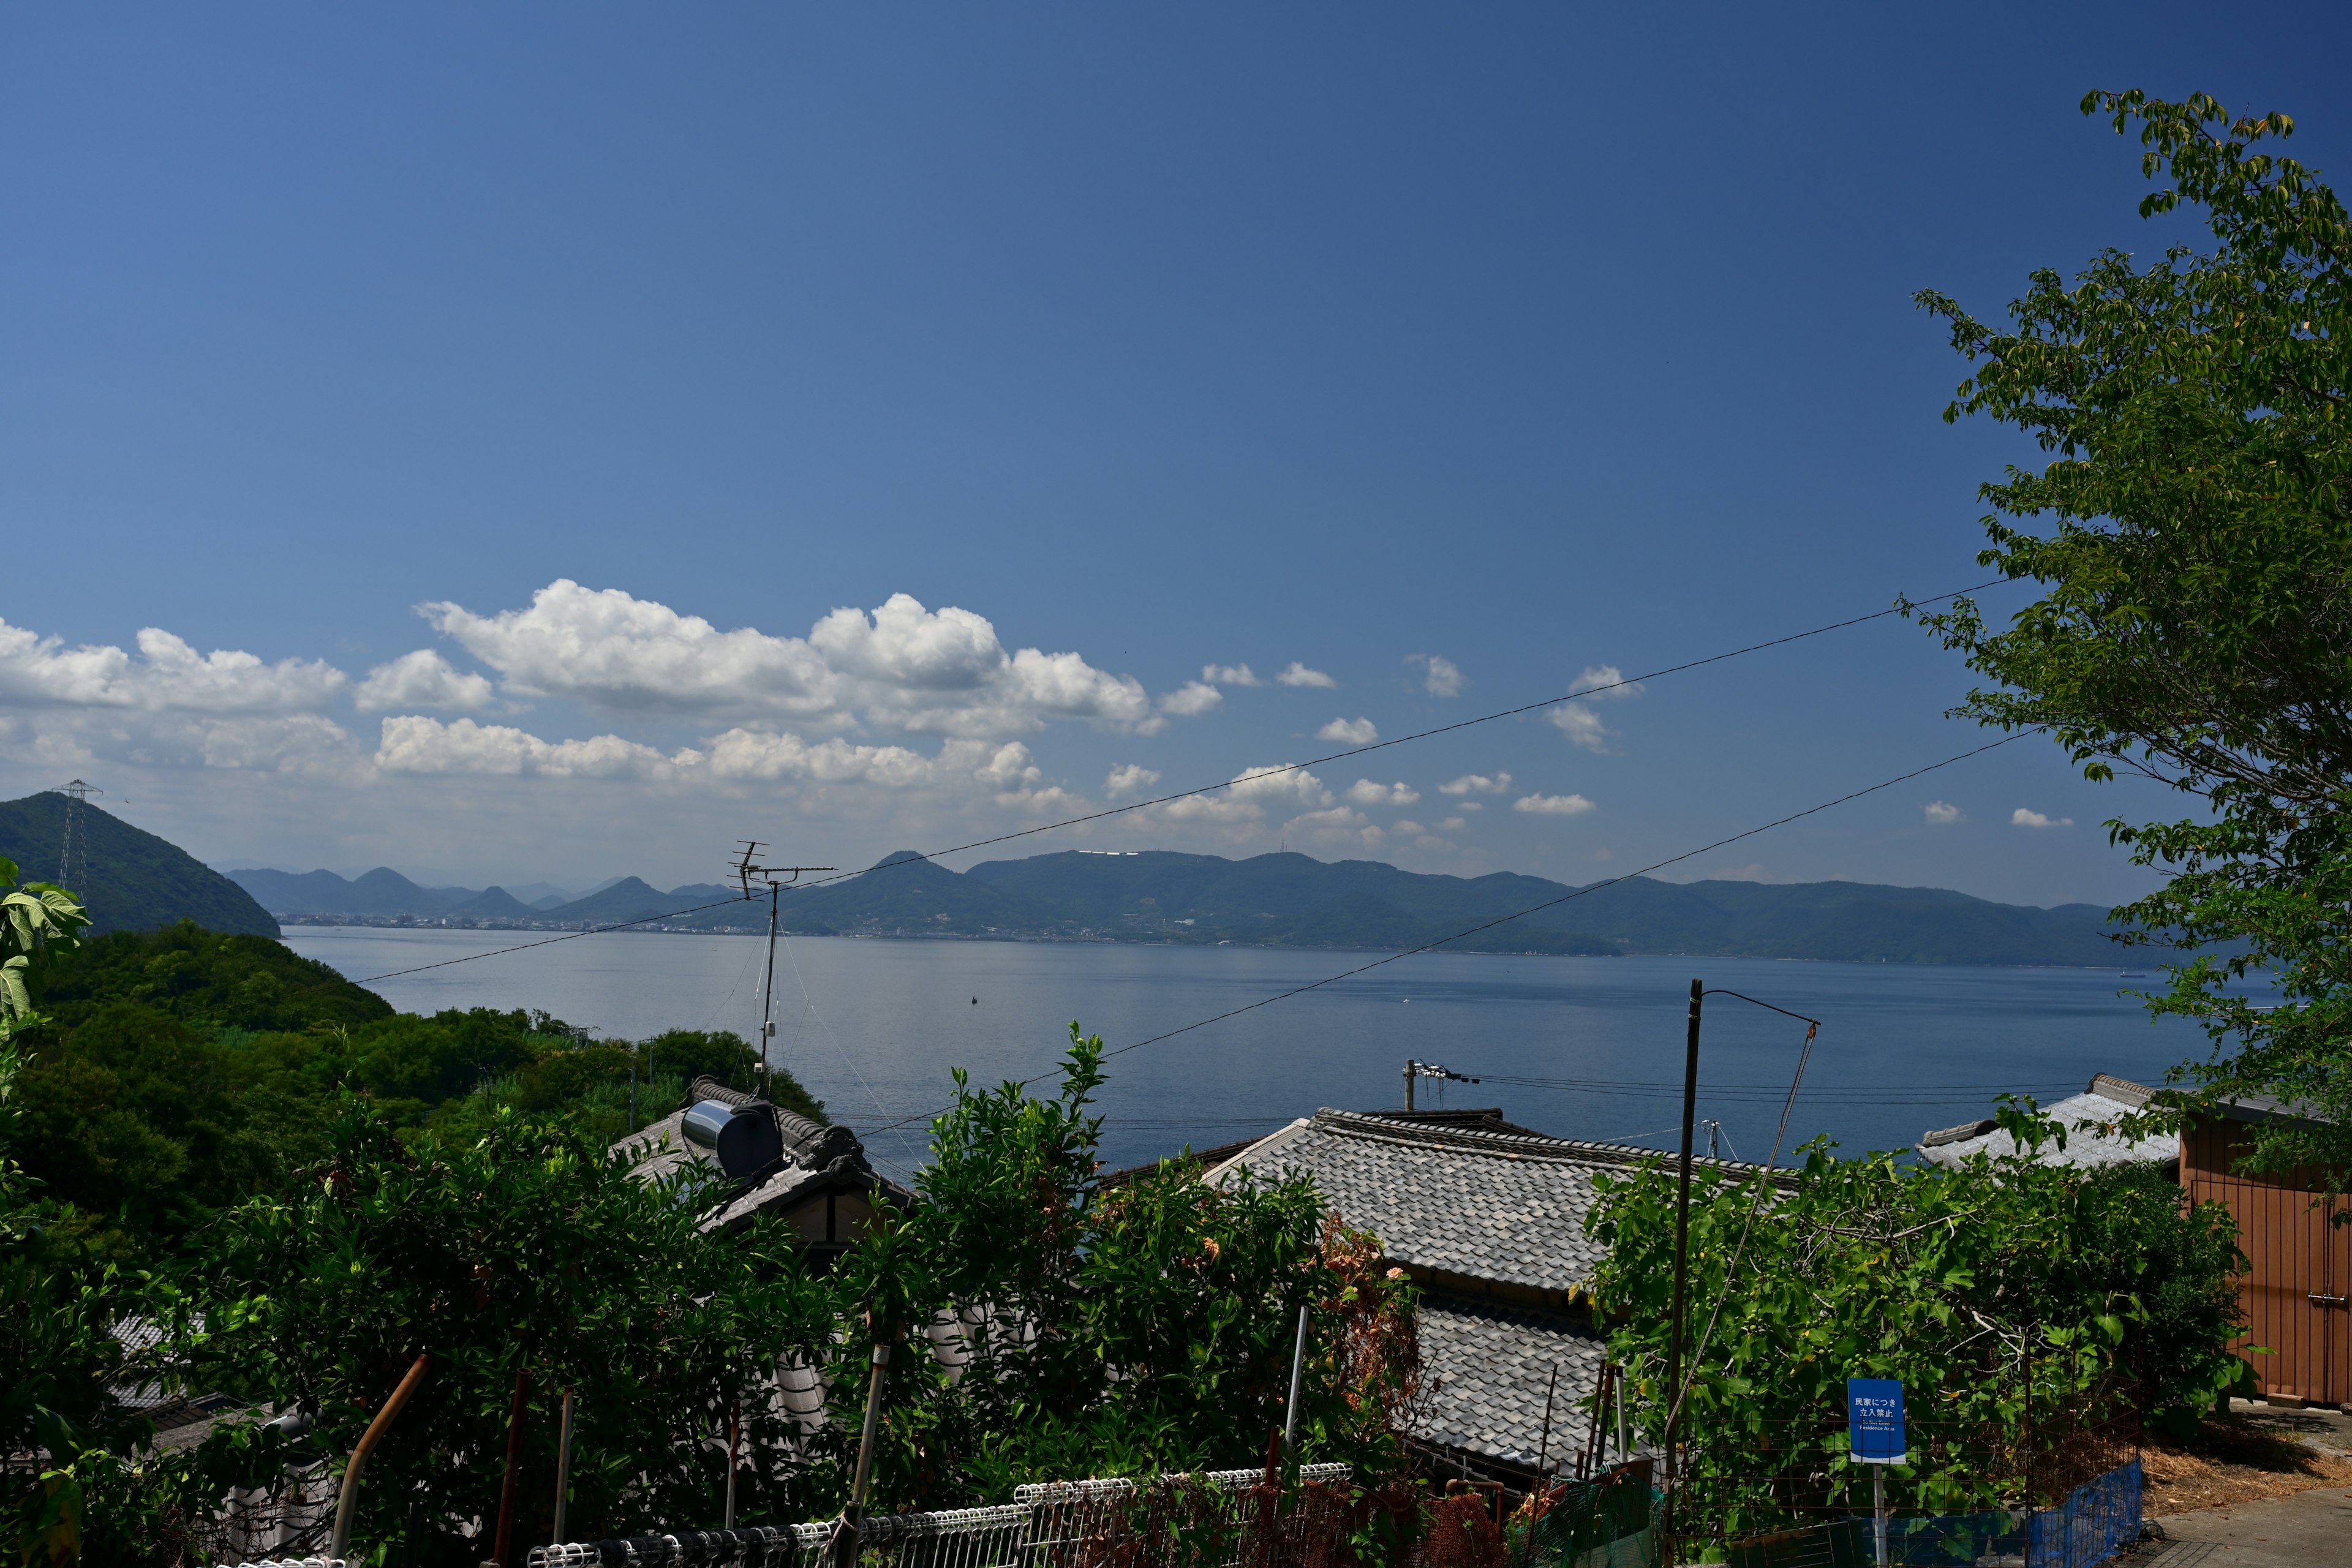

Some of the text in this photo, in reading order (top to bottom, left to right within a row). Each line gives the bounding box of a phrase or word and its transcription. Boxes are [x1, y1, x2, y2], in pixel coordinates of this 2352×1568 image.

[1855, 1398, 1895, 1407] 民家につき
[1860, 1408, 1893, 1417] 立入禁止
